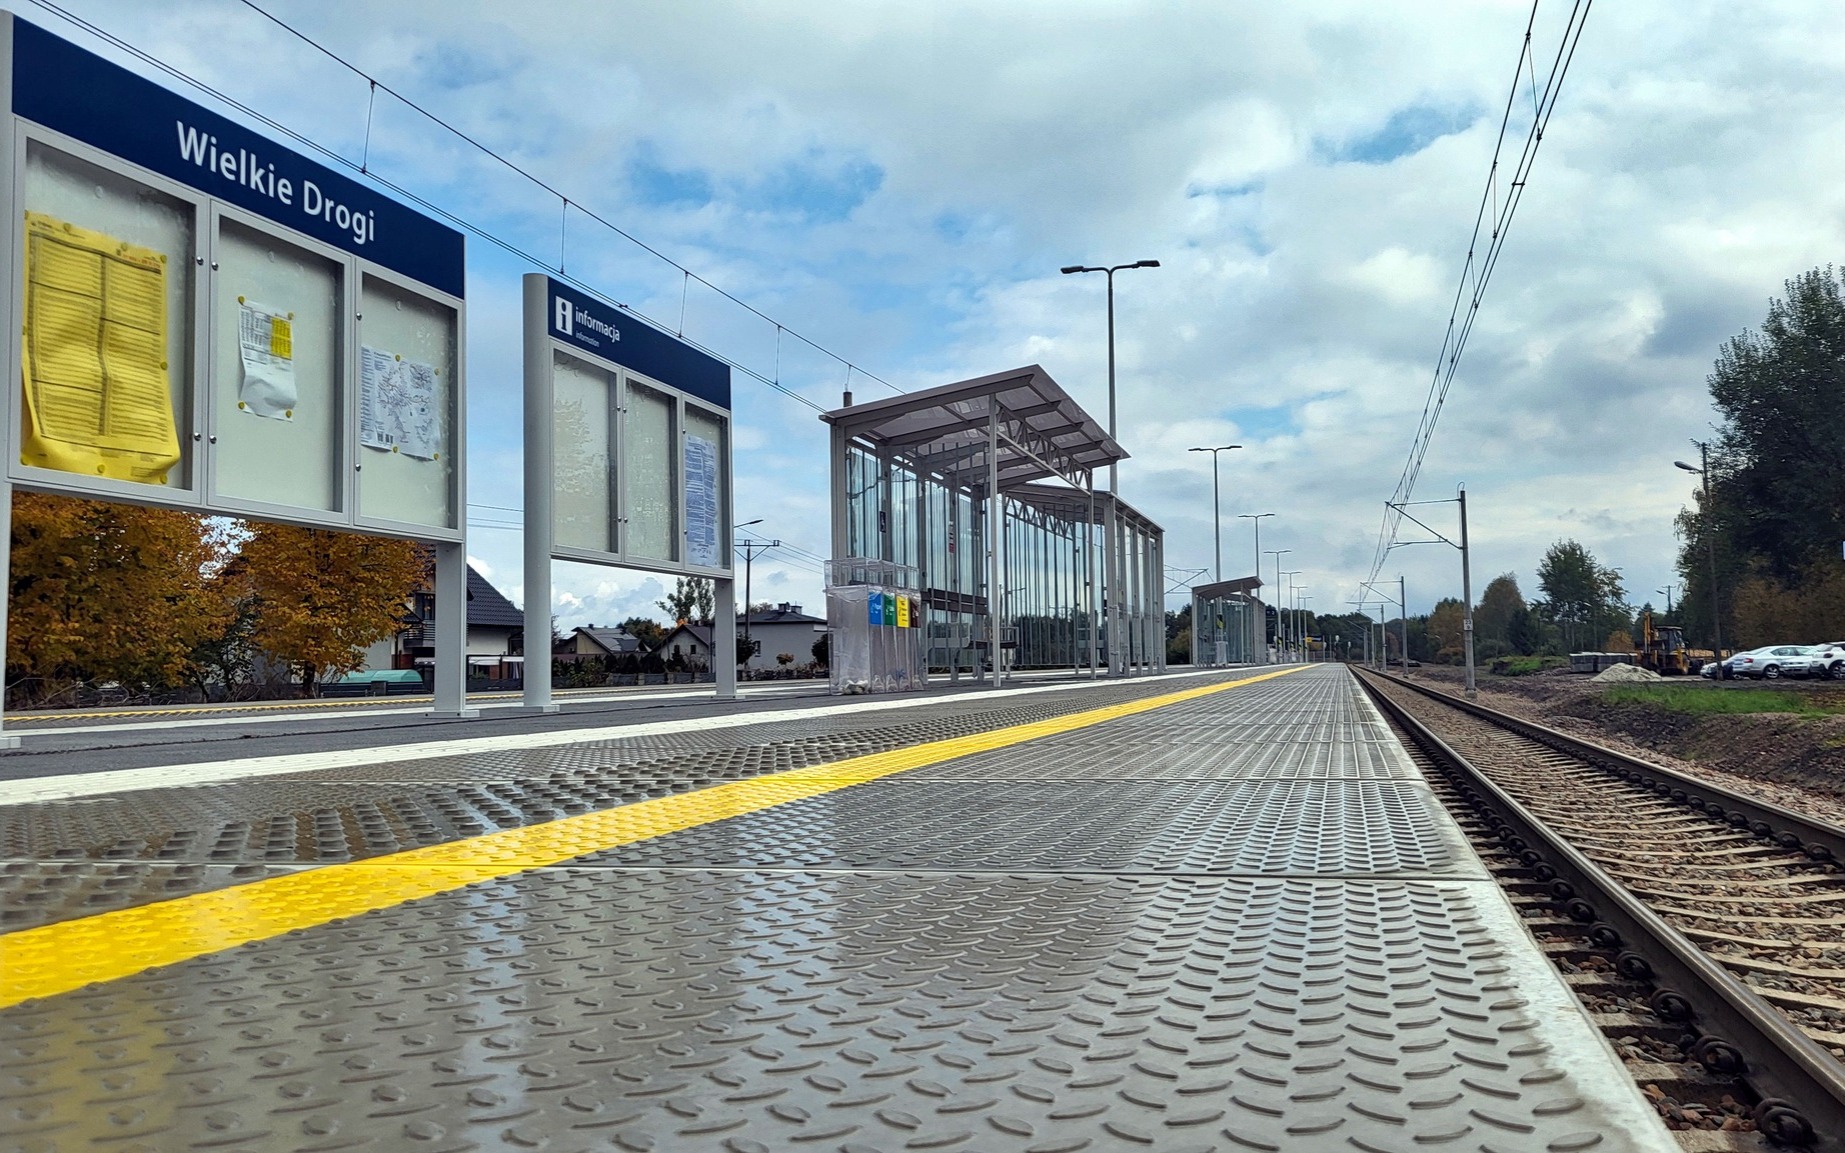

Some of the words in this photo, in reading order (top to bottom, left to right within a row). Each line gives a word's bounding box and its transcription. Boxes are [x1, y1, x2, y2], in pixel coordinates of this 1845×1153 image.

[177, 120, 293, 205] Wielkie
[303, 180, 374, 245] Drogi
[575, 306, 620, 343] informacja
